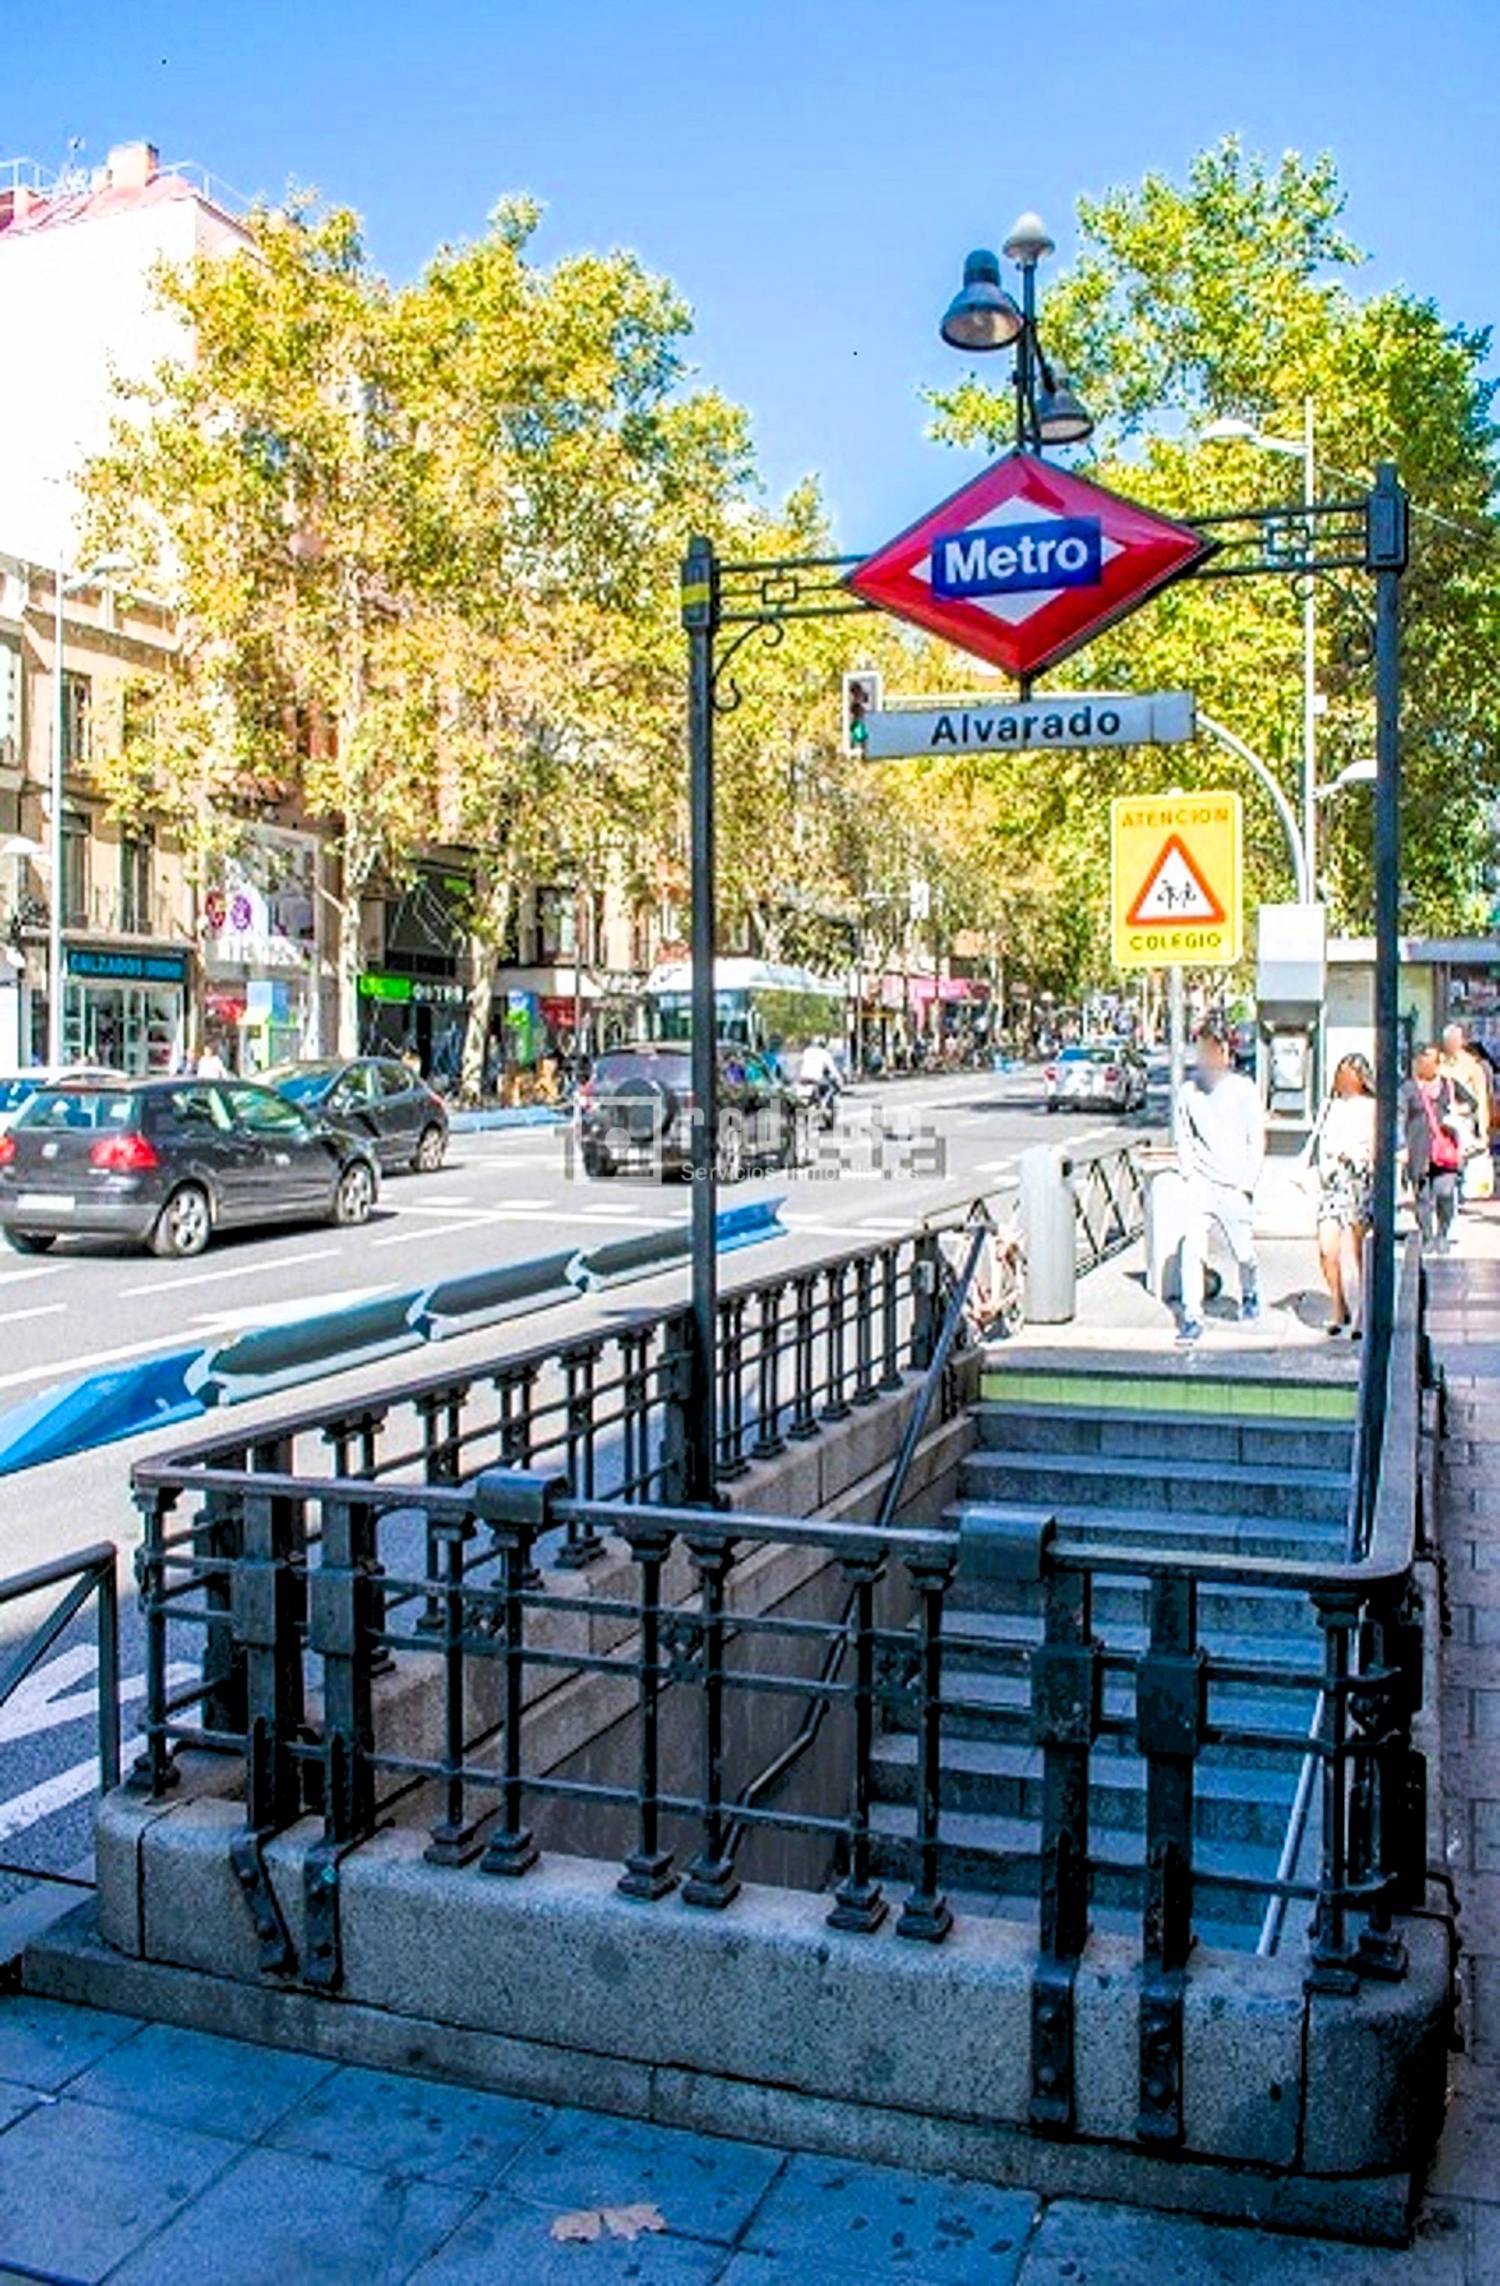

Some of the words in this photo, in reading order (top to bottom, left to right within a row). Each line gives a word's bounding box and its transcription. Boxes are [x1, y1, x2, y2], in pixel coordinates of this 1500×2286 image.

[944, 535, 1089, 585] Metro
[931, 705, 1121, 746] Alvarado
[1121, 808, 1229, 828] ATENCION
[1129, 931, 1222, 951] COLEGIO
